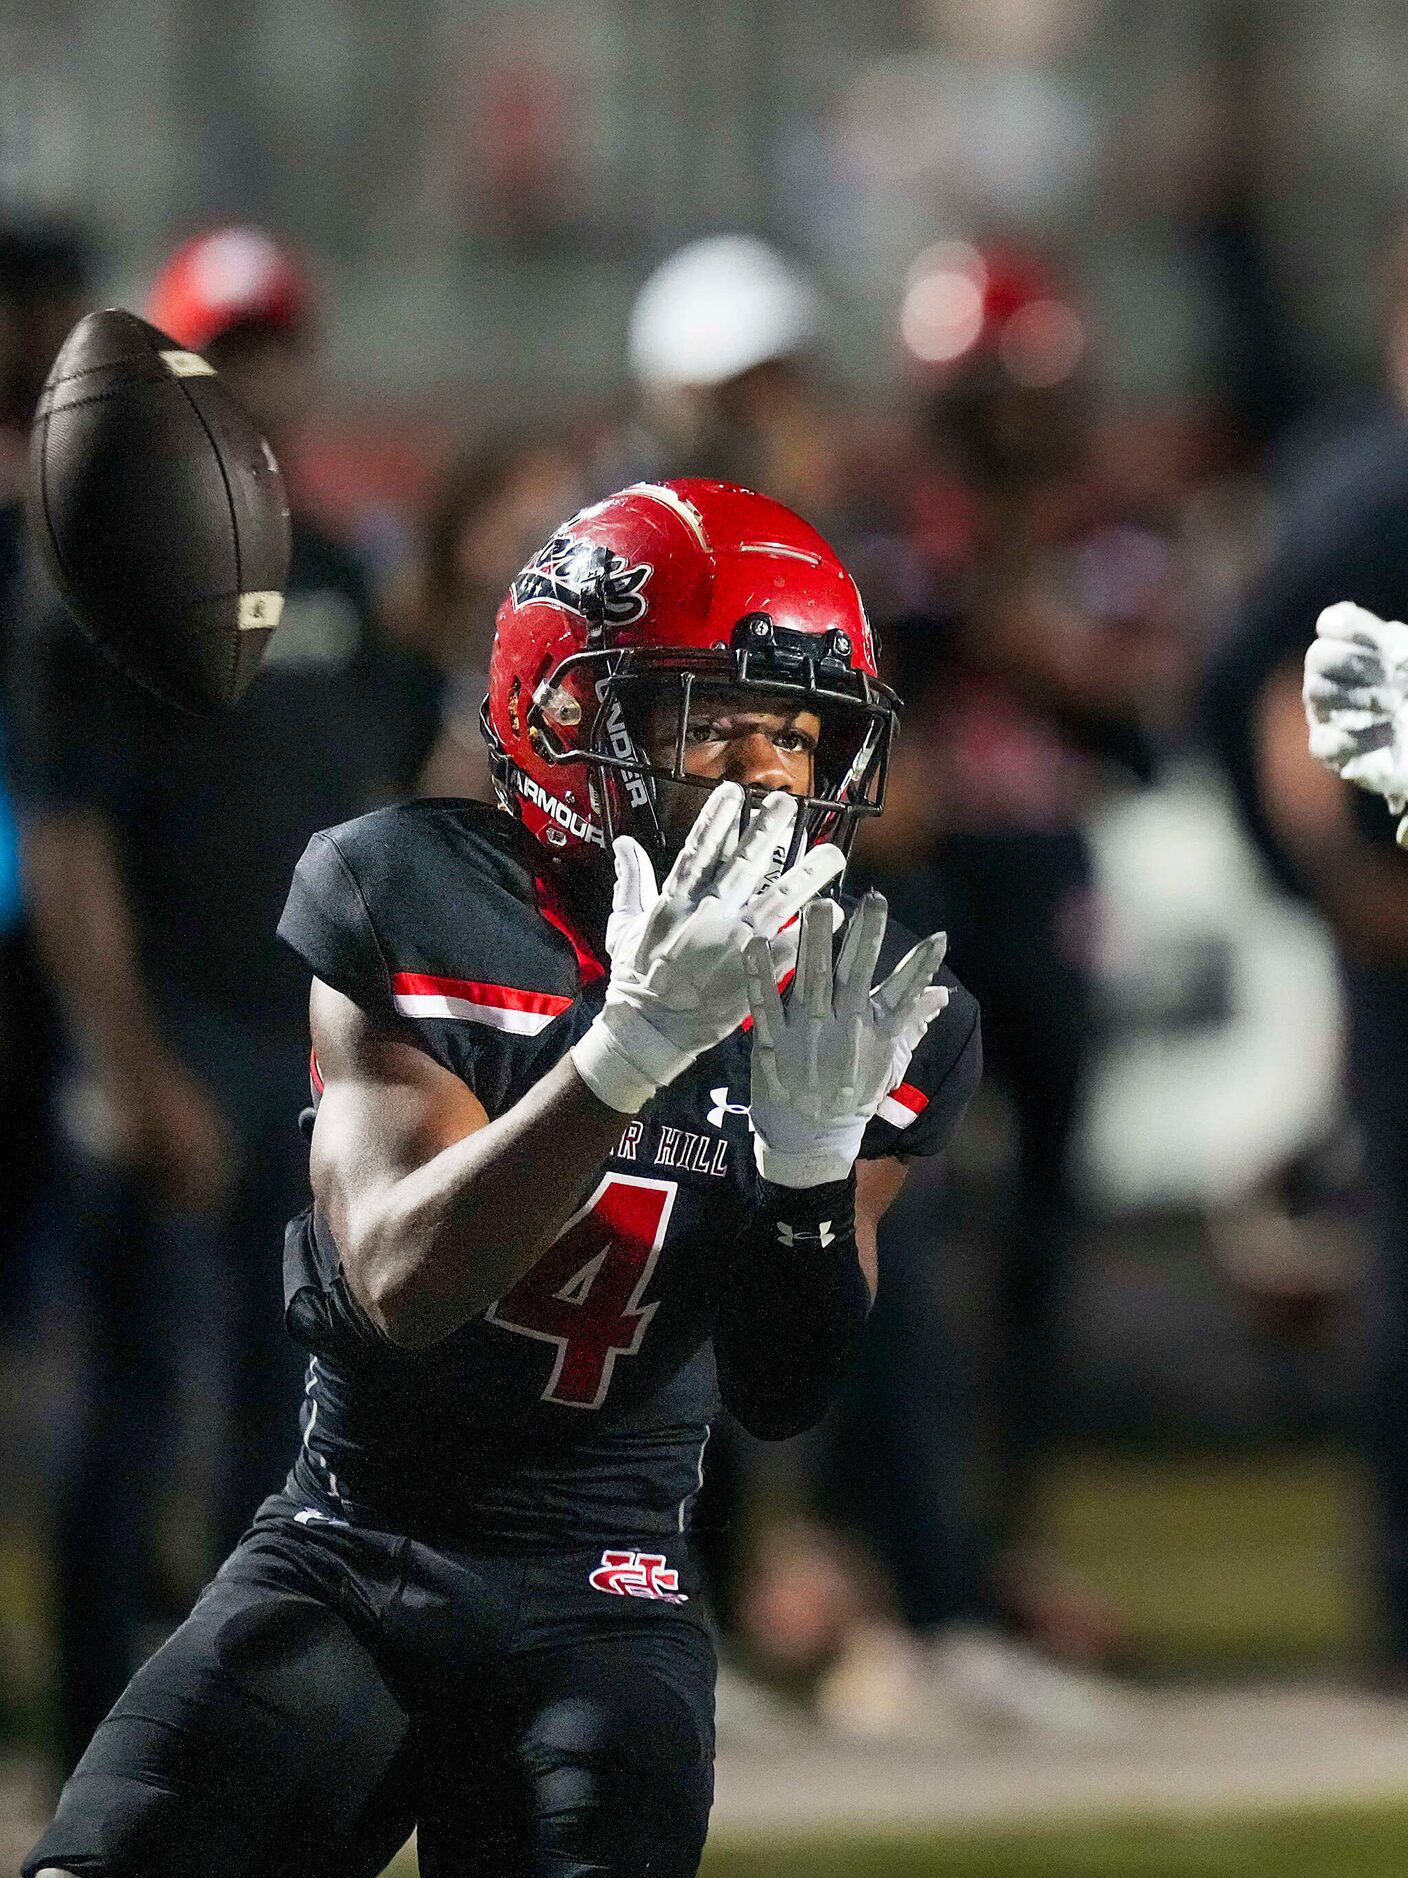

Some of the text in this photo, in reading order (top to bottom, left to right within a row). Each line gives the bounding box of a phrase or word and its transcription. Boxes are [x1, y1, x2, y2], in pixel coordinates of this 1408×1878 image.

[510, 768, 607, 850] ARMOUR
[653, 1125, 729, 1177] HILL
[484, 1170, 679, 1411] 4
